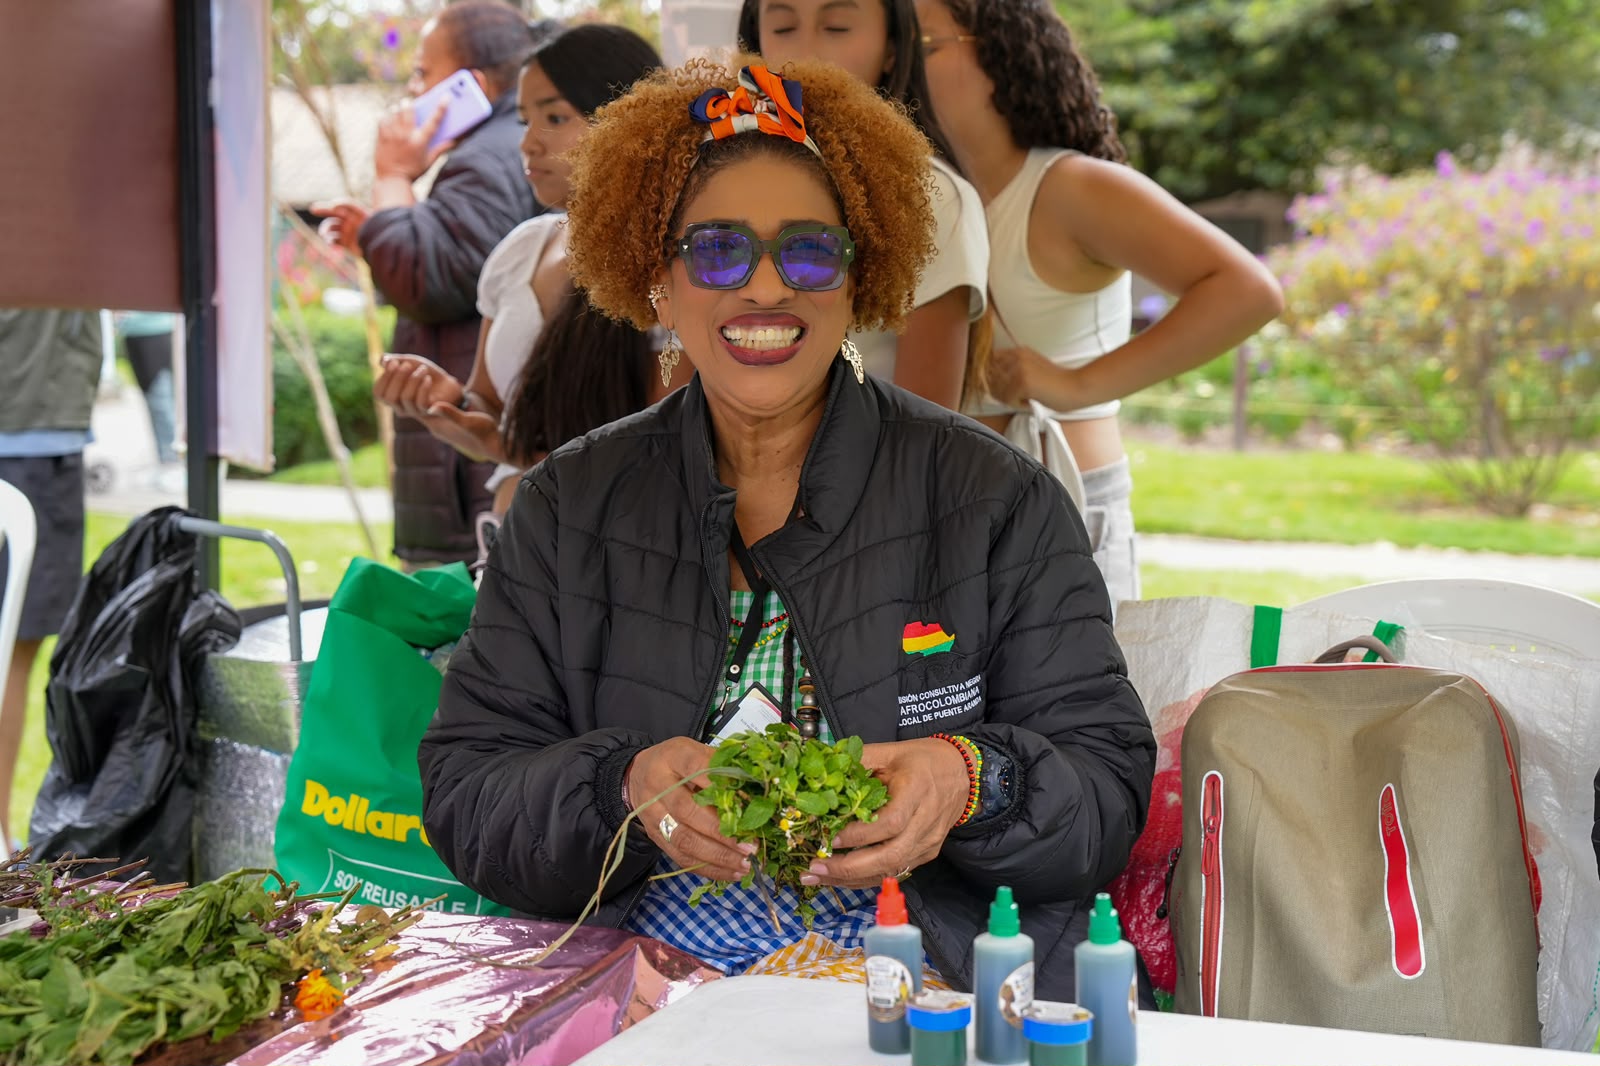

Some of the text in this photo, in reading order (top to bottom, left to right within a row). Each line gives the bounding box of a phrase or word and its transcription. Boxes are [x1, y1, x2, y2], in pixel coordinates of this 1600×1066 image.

[920, 683, 965, 700] CONSULTIVA
[900, 686, 980, 716] AFROCOLOMBIANA
[923, 713, 934, 722] DE
[934, 706, 963, 720] PUENTE
